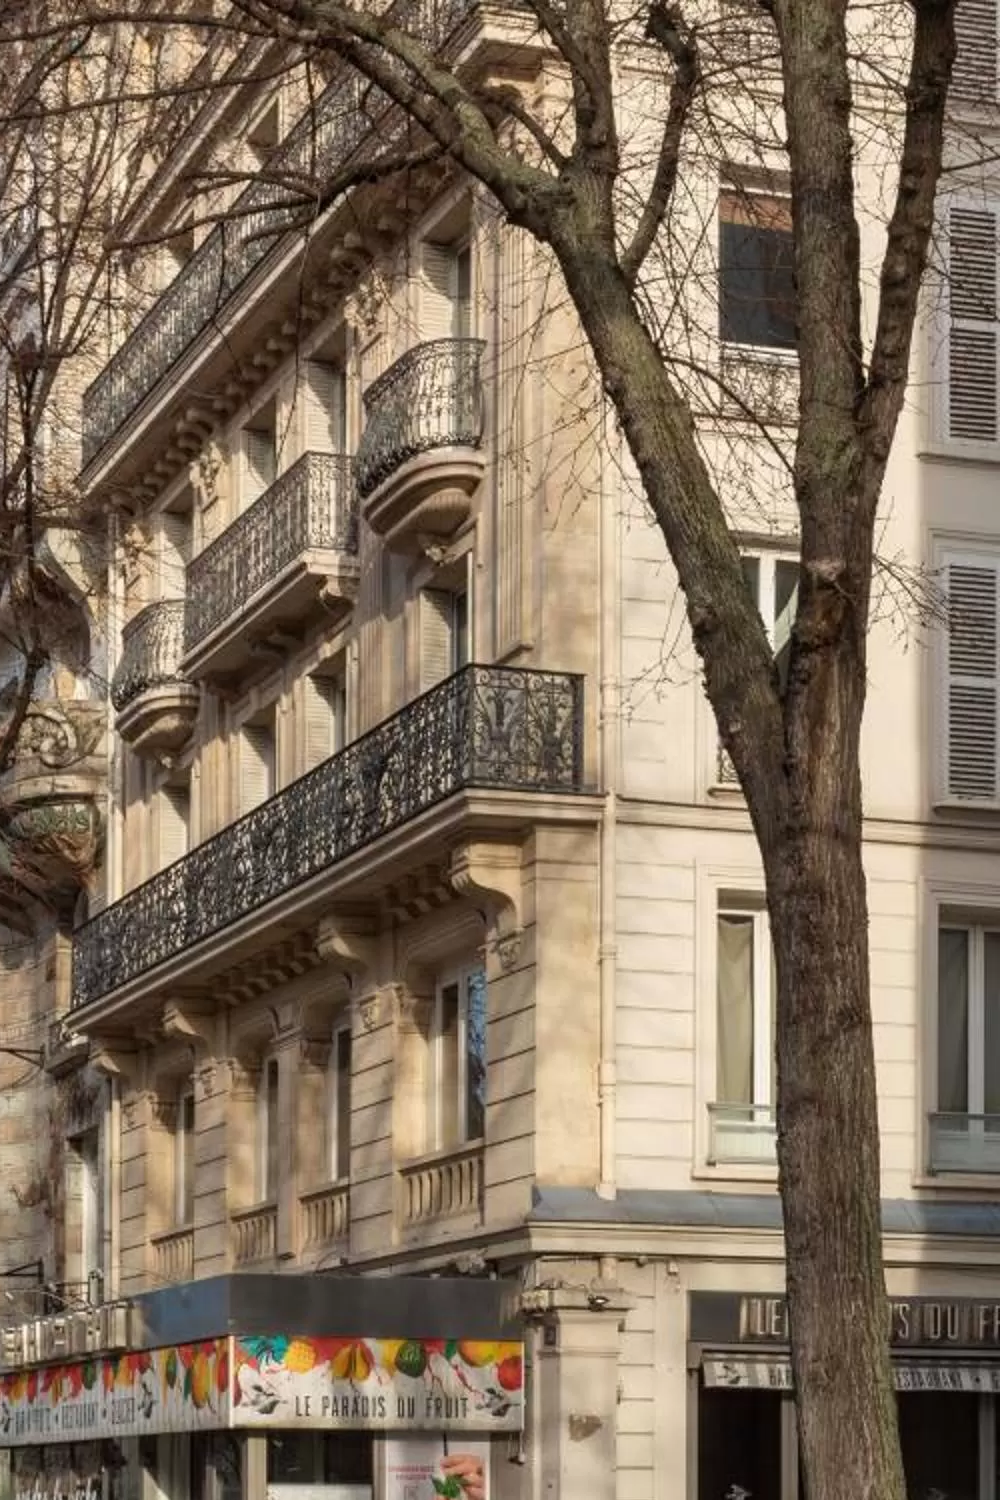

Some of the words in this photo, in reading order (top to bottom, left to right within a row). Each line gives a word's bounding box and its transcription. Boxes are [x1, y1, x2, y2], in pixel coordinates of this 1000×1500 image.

[928, 1303, 960, 1340] DU
[295, 1395, 311, 1417] LE
[321, 1395, 386, 1418] PARADIS
[397, 1395, 415, 1418] DU
[426, 1395, 469, 1418] FRUIT
